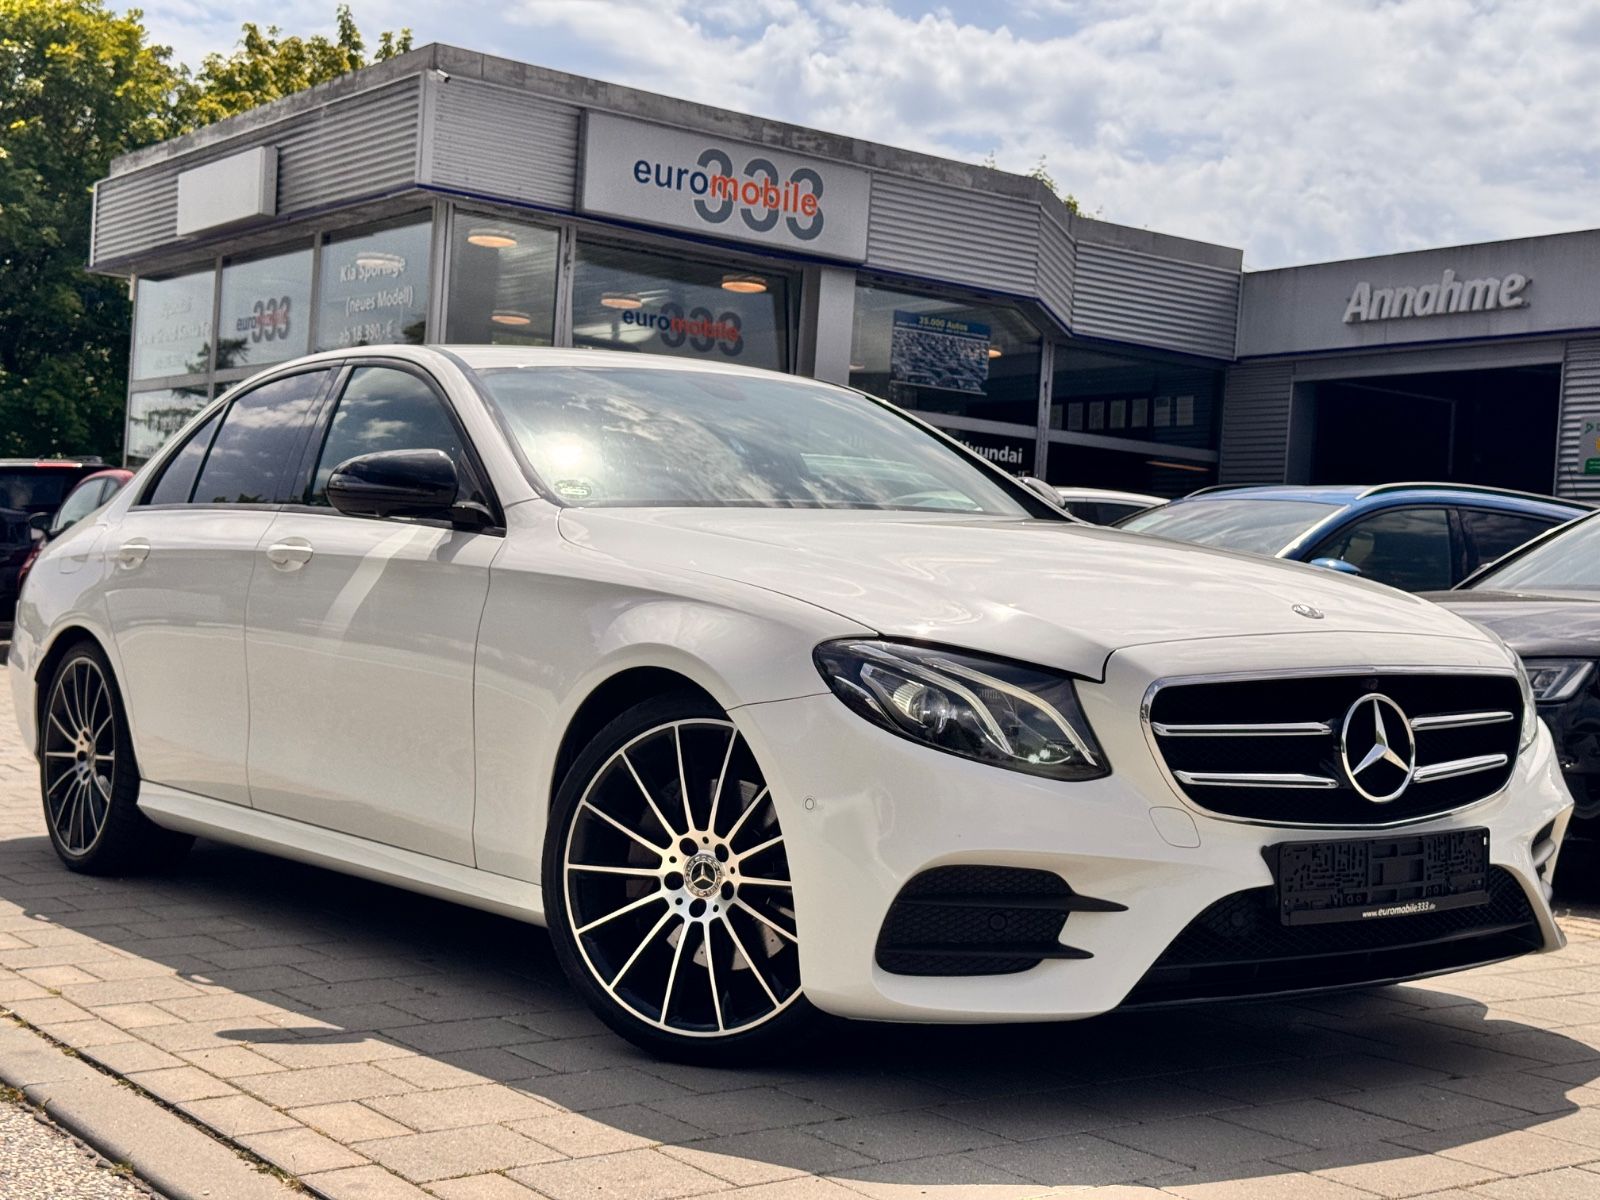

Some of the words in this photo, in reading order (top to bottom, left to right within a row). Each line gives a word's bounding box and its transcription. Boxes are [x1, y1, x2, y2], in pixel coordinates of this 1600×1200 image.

[633, 159, 817, 217] euromobile
[693, 148, 824, 240] 333
[340, 264, 357, 281] Kia
[1342, 268, 1528, 323] Annahme
[251, 295, 291, 343] 333
[660, 302, 744, 357] 333
